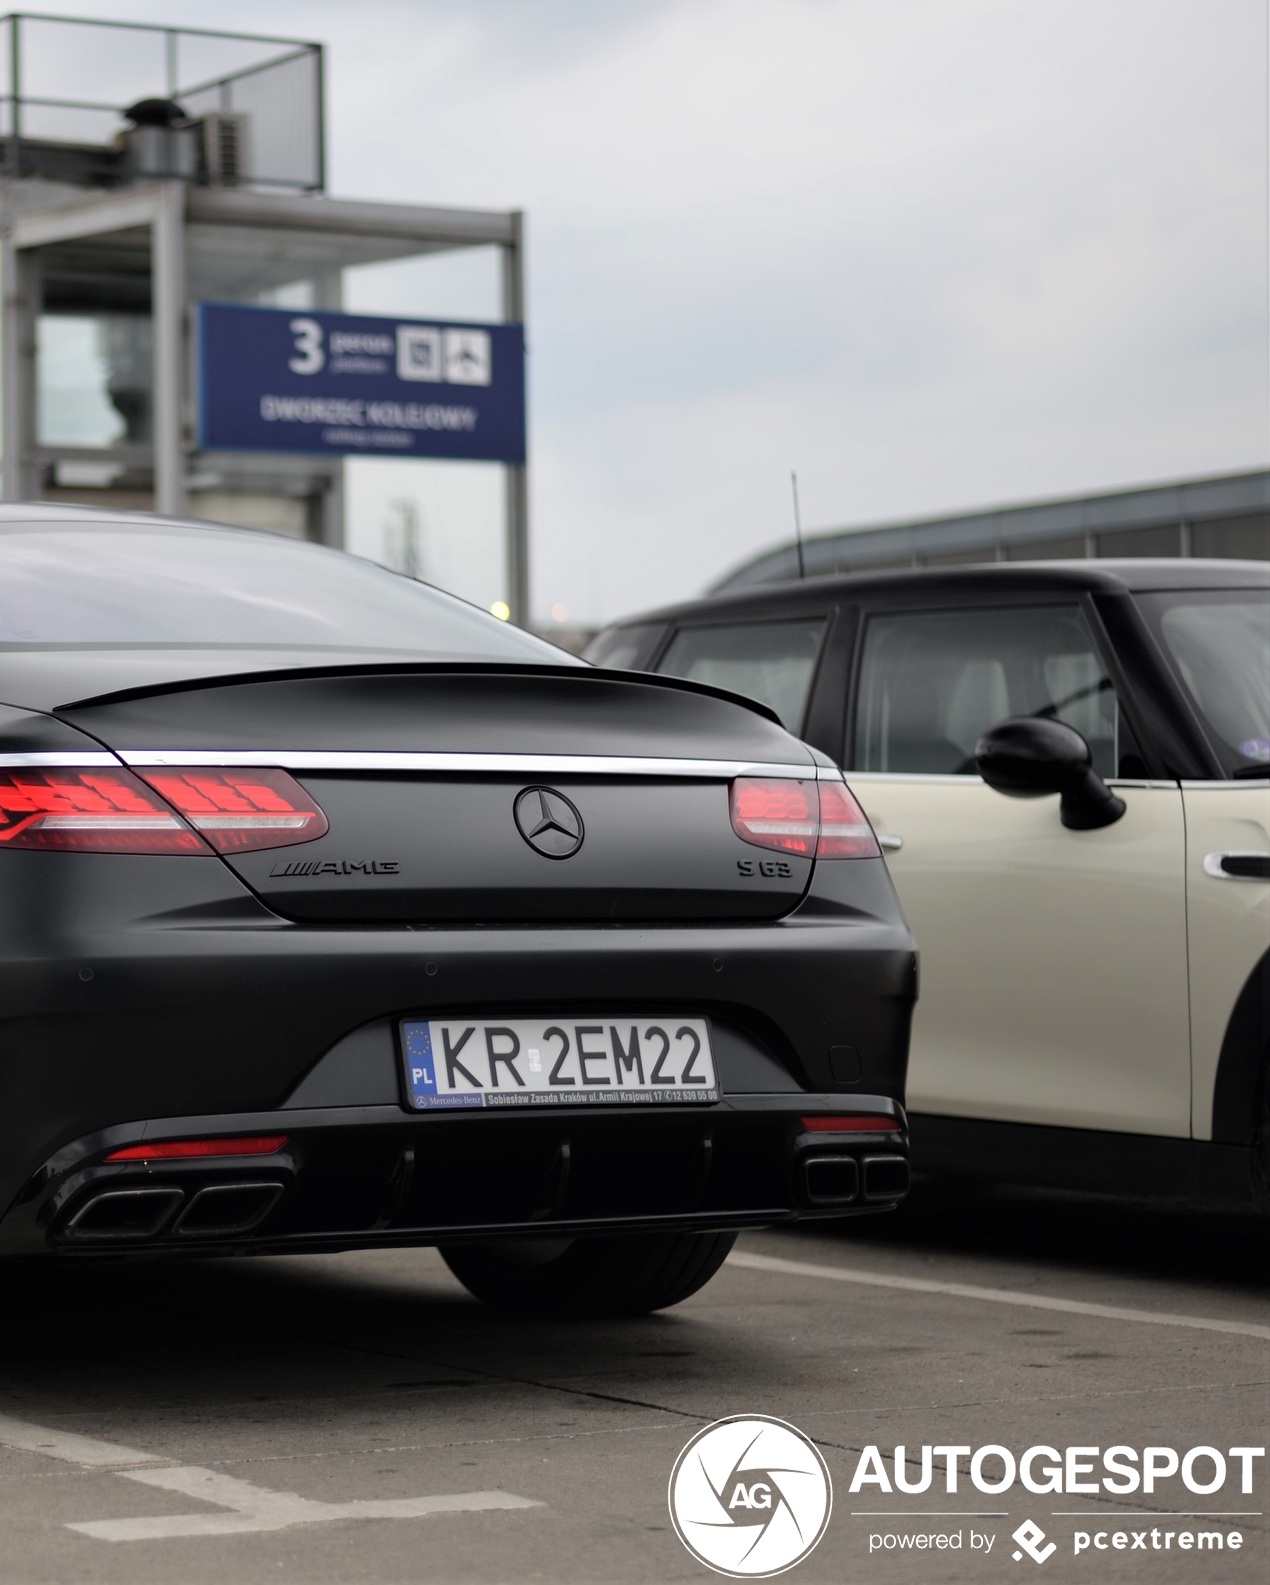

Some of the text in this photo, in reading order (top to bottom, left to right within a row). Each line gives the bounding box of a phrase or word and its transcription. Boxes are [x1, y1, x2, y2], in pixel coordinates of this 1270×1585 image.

[287, 318, 325, 375] 3
[260, 394, 478, 432] DWORZEC KOLEJOWY
[736, 858, 793, 878] S 63
[441, 1025, 706, 1088] KR 2EM22
[412, 1067, 433, 1085] PL
[429, 1095, 482, 1106] Mercedes-Benz
[488, 1094, 529, 1105] Sobiesław
[530, 1093, 558, 1103] Zasada
[559, 1091, 587, 1102] Kraków
[620, 1091, 652, 1103] Krajowej
[653, 1091, 662, 1101] 17
[683, 1091, 697, 1100] 639
[698, 1091, 707, 1100] 55
